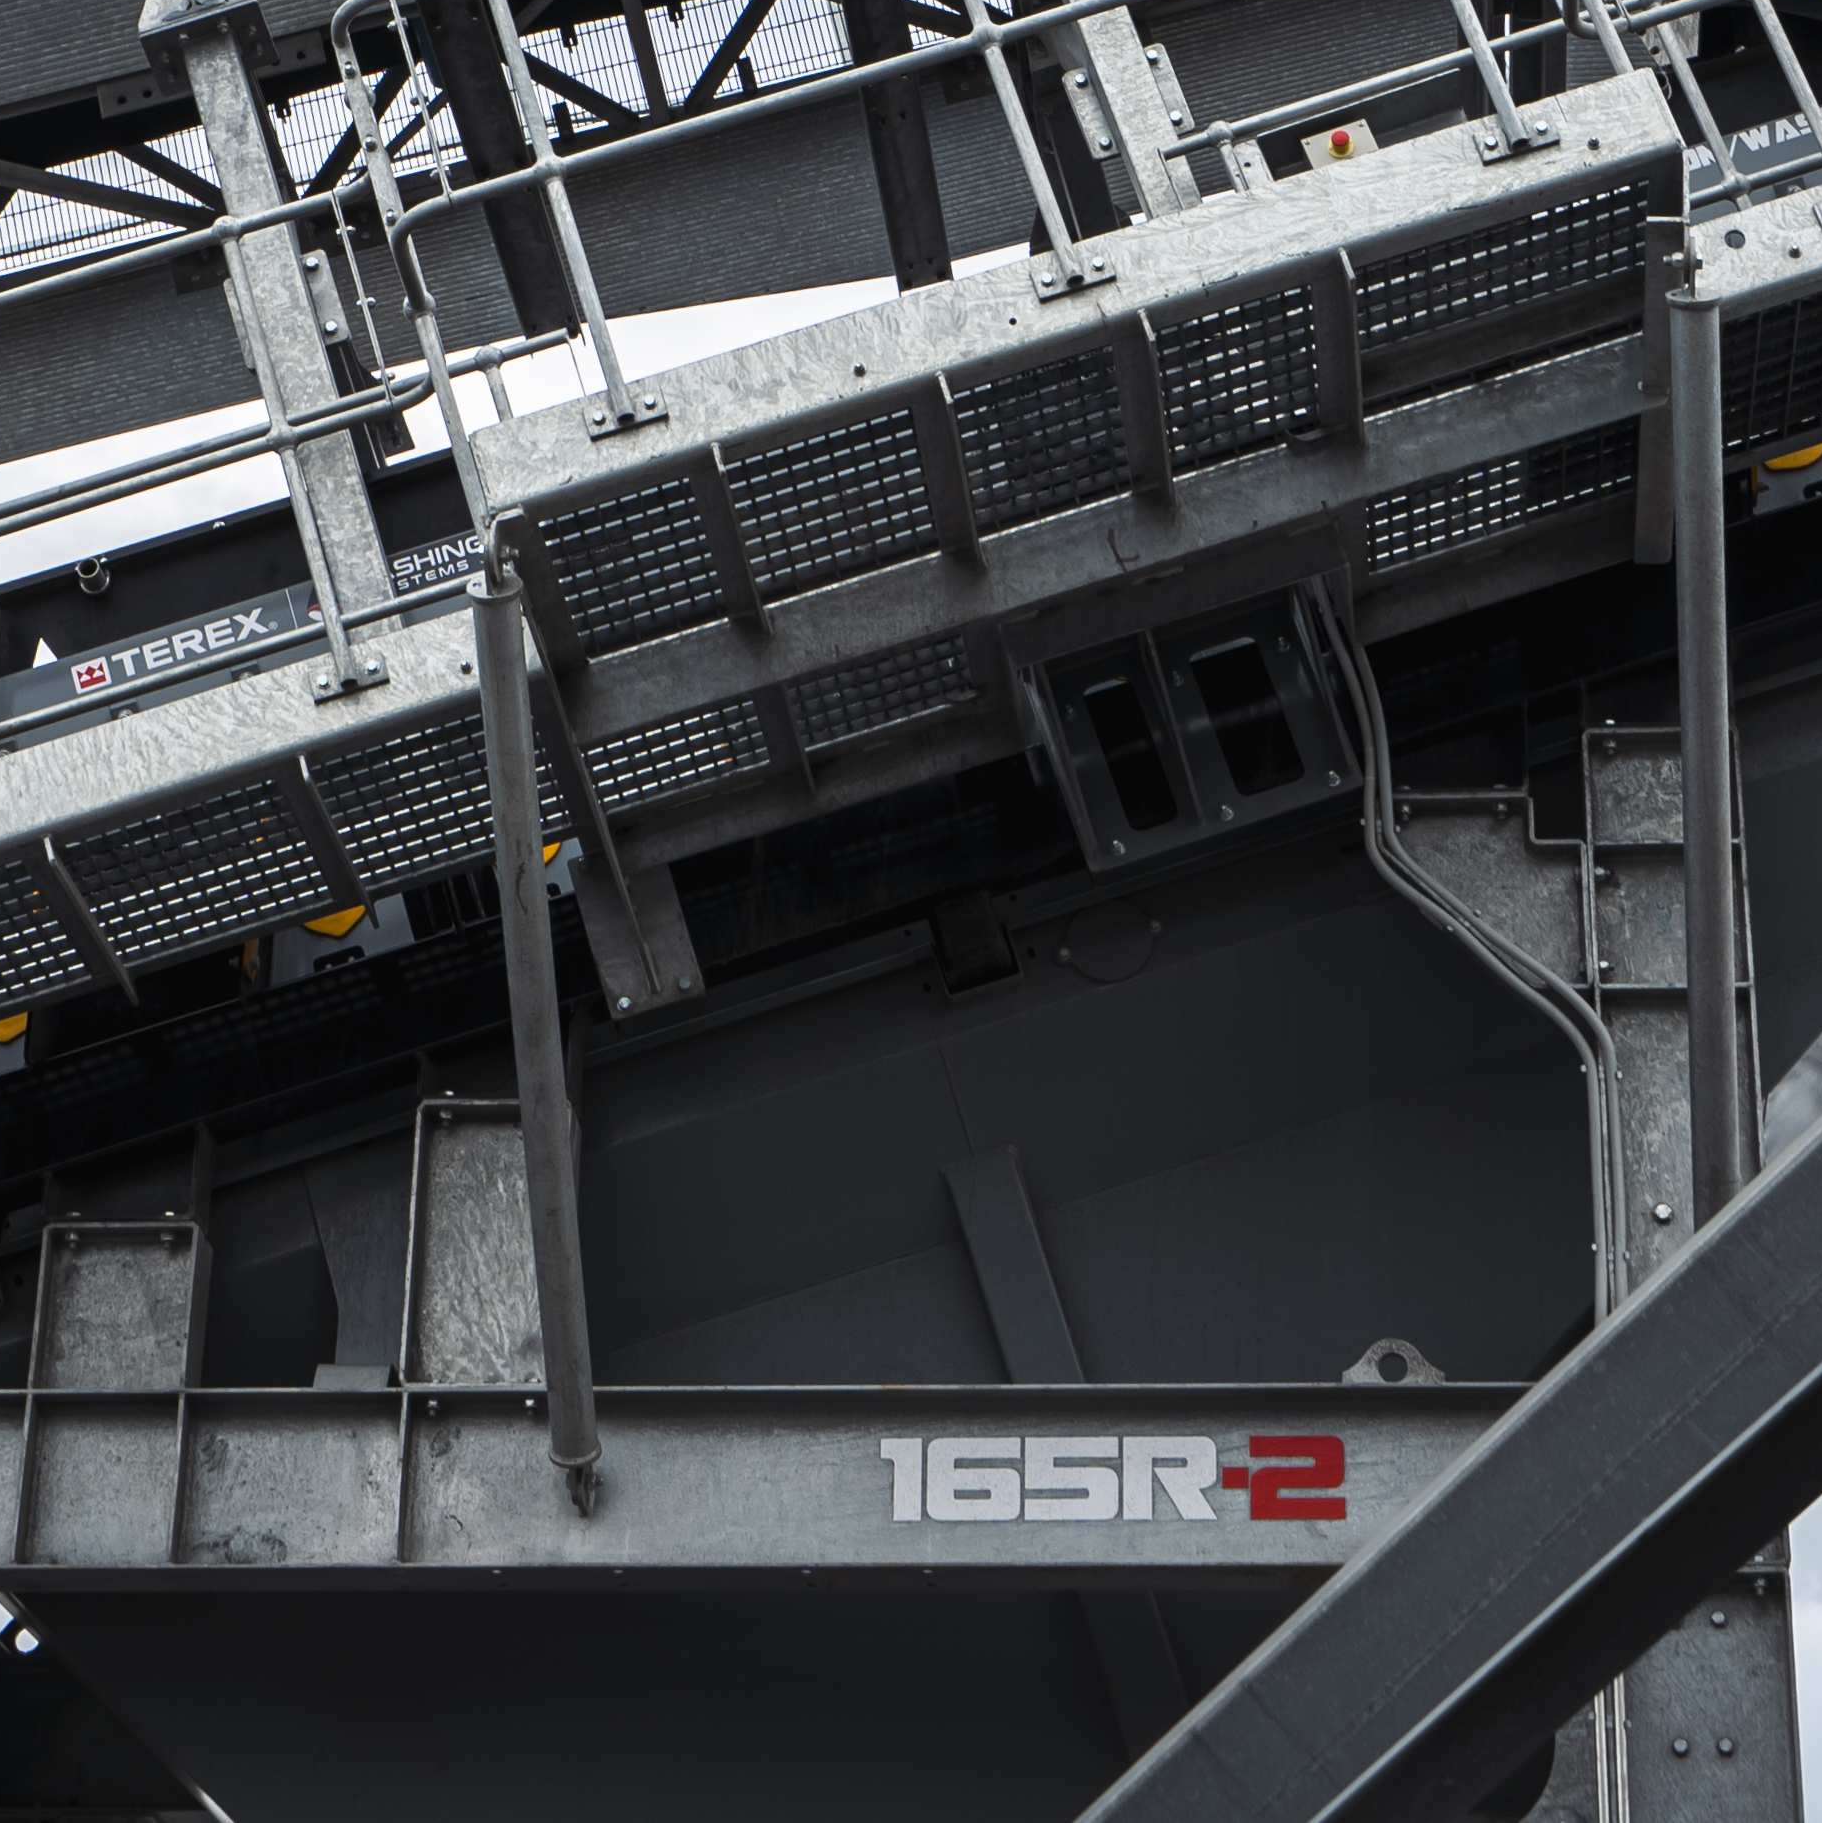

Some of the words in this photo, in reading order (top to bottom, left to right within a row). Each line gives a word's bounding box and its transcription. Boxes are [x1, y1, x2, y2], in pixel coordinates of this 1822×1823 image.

[390, 535, 482, 579] SHING
[397, 559, 469, 591] STEMS
[880, 1435, 1346, 1522] 165R-2
